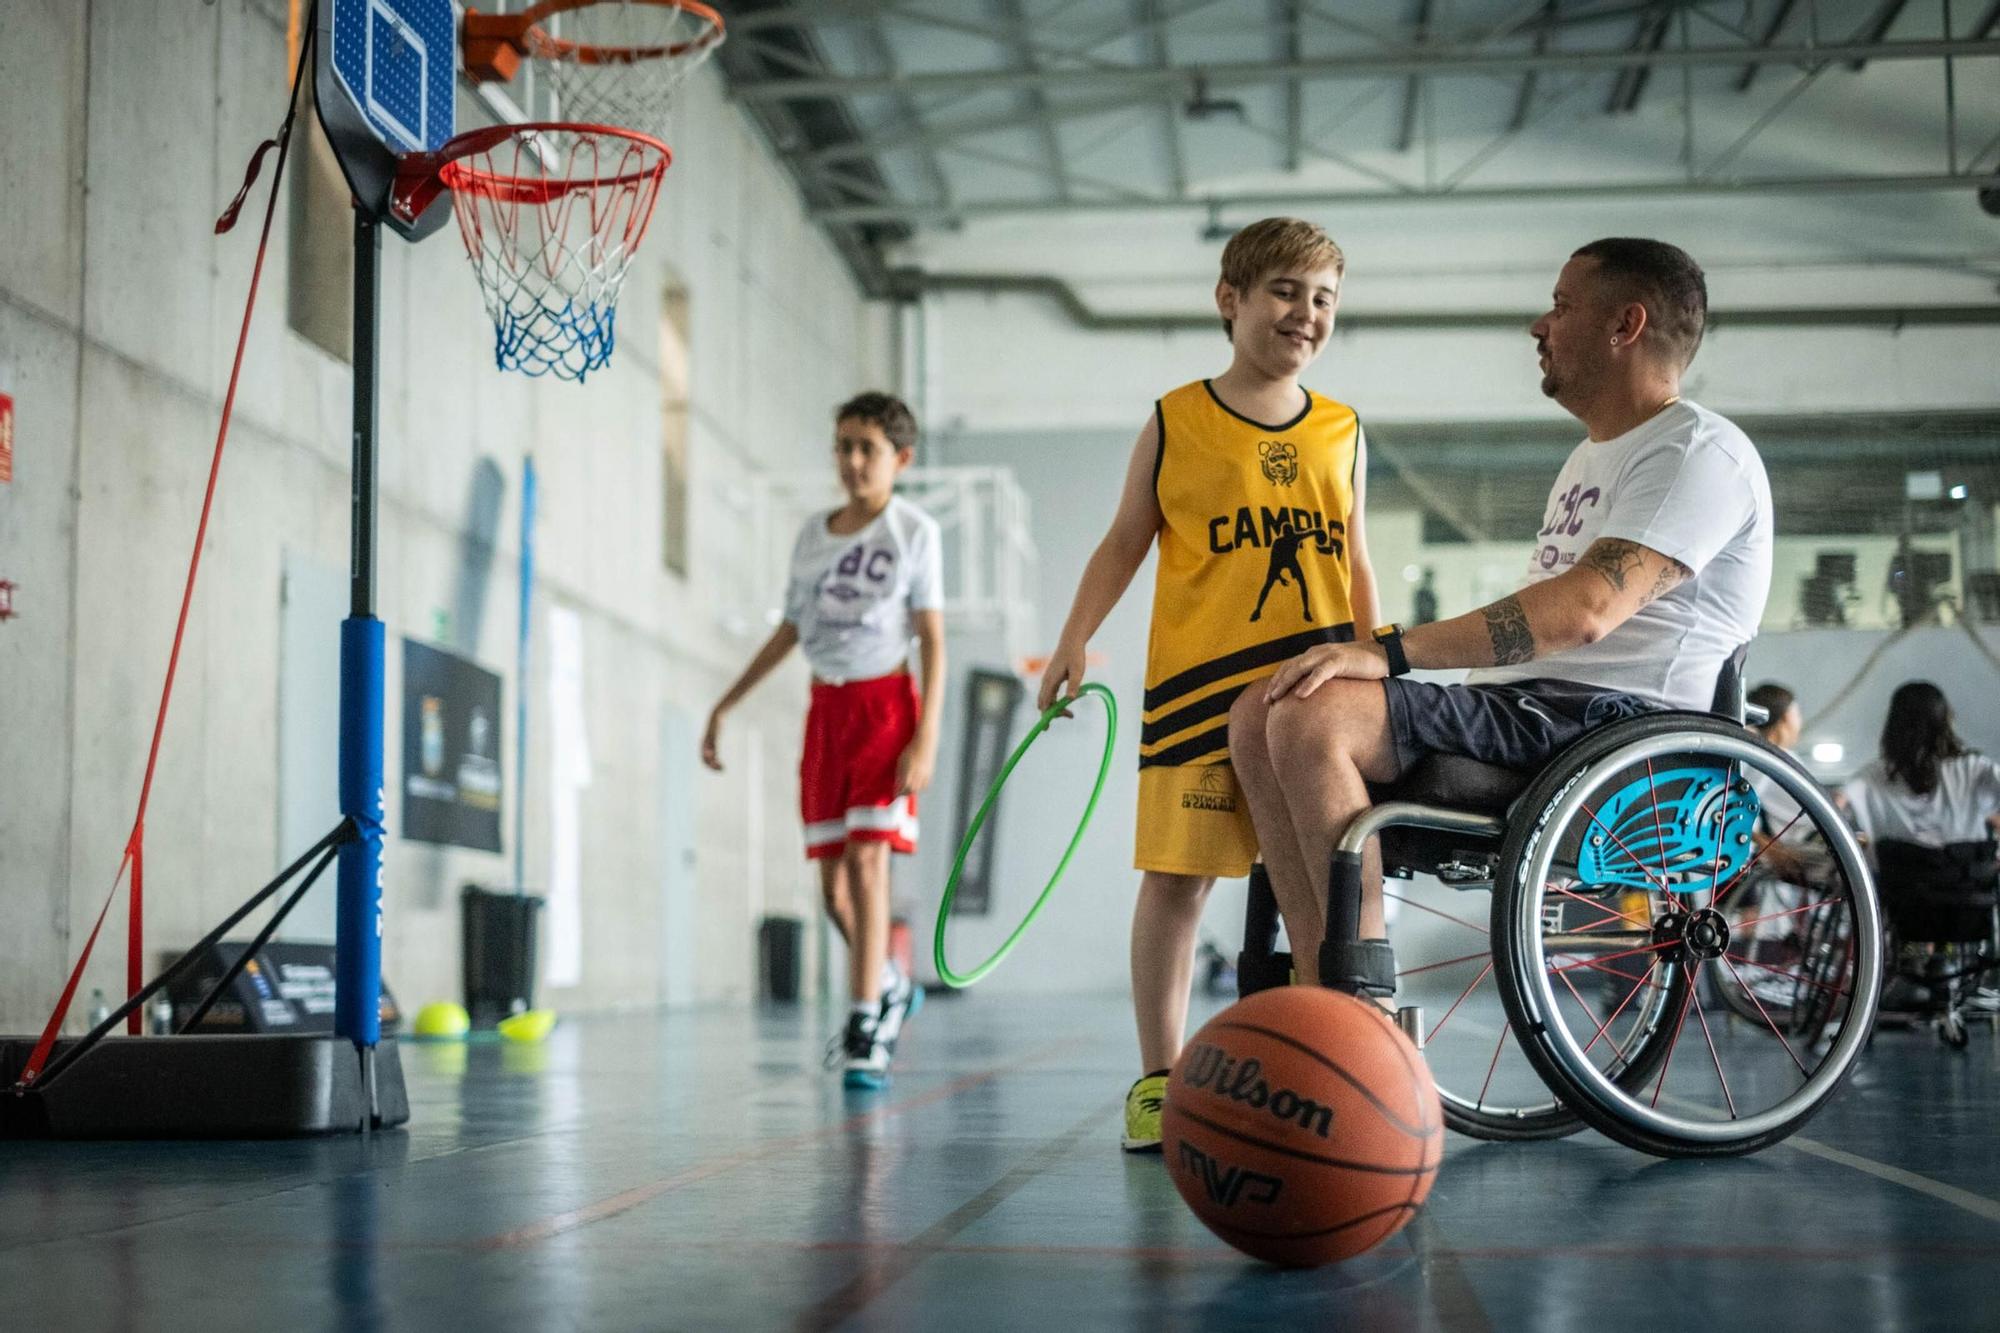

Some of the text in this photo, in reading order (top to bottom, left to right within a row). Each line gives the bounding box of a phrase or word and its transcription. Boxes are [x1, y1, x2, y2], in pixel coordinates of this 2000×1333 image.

[1209, 506, 1345, 561] CAMPUS
[1183, 1042, 1333, 1138] Wilson
[1178, 1139, 1283, 1207] MVP
